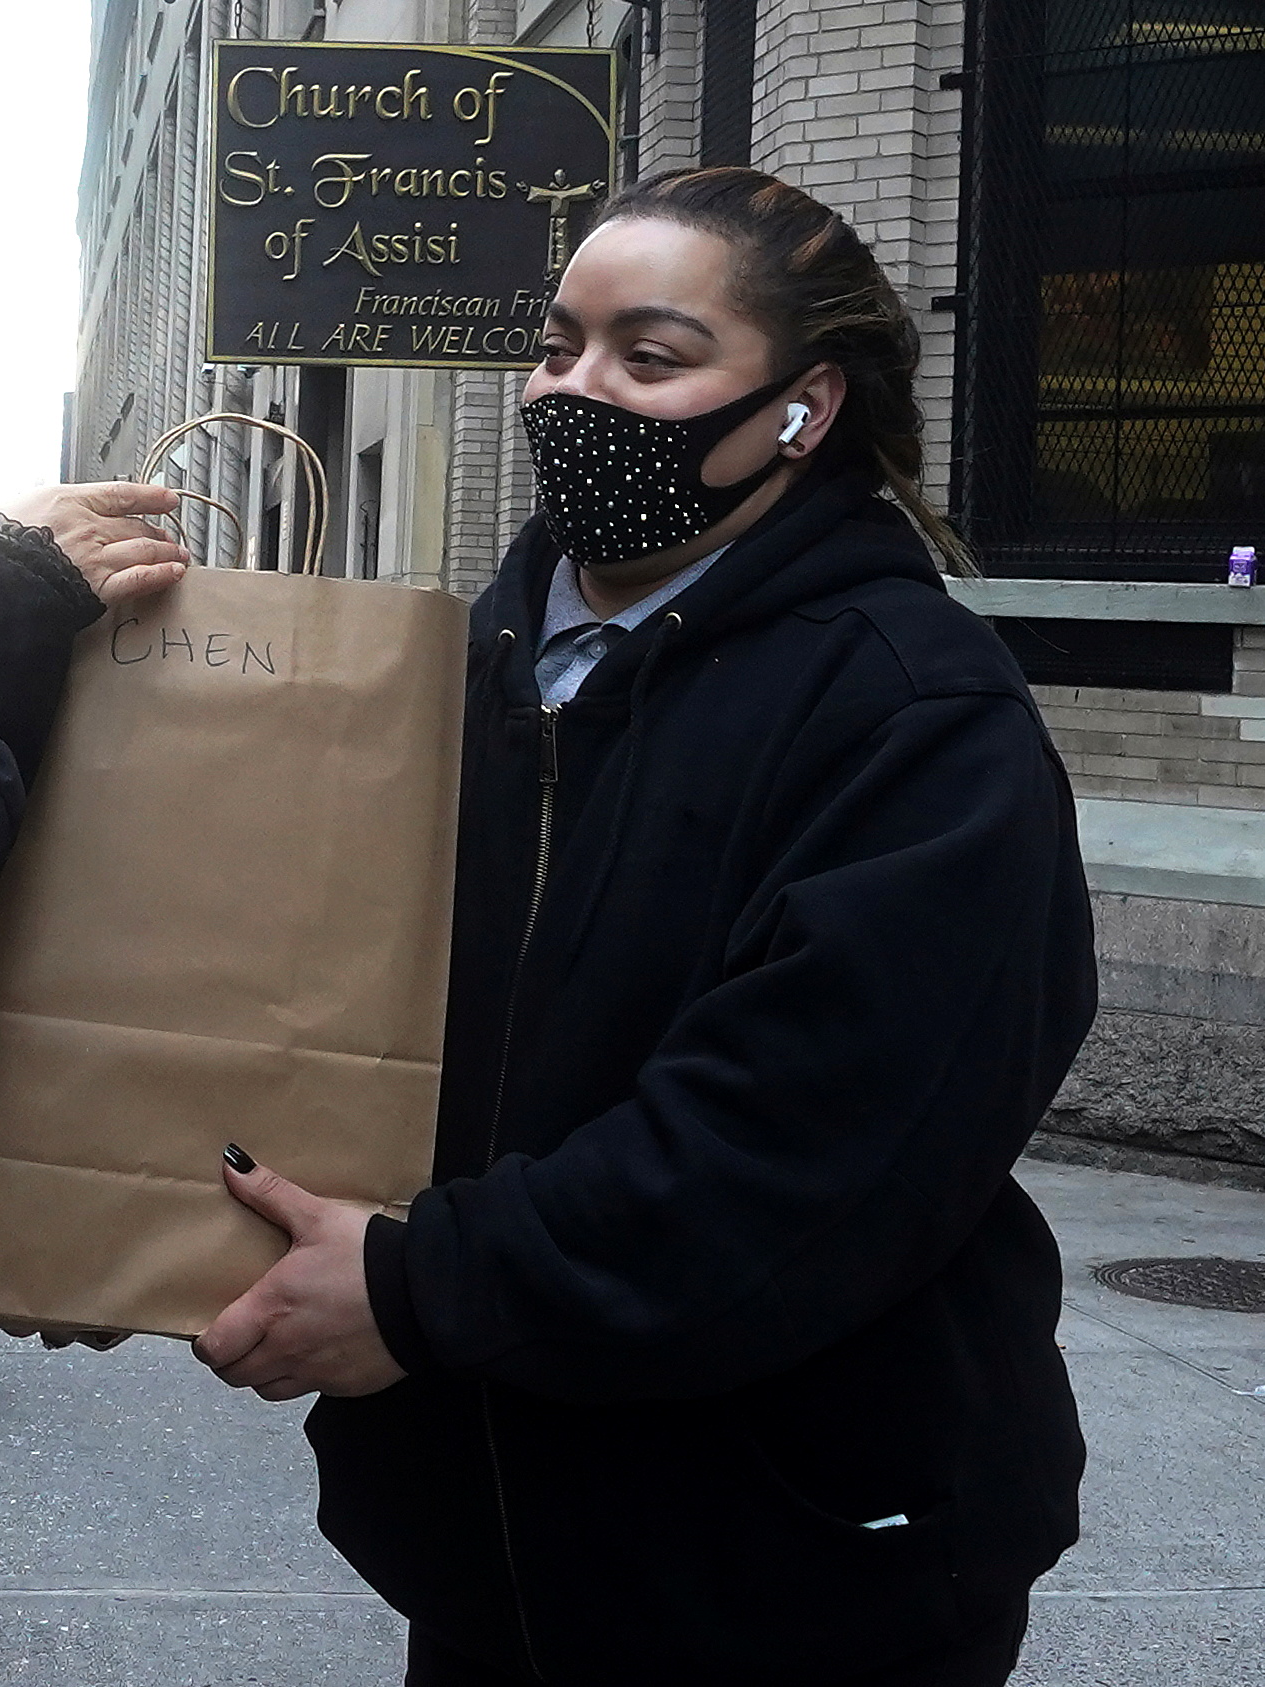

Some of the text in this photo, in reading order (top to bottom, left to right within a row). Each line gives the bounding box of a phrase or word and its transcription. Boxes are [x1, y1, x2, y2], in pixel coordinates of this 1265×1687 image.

[226, 66, 515, 146] Church of
[219, 151, 508, 209] St. Francis
[264, 218, 461, 281] of Assisi
[354, 286, 550, 319] Franciscan Fri
[245, 322, 306, 351] ALL
[321, 323, 393, 352] ARE
[111, 618, 276, 675] CHEN
